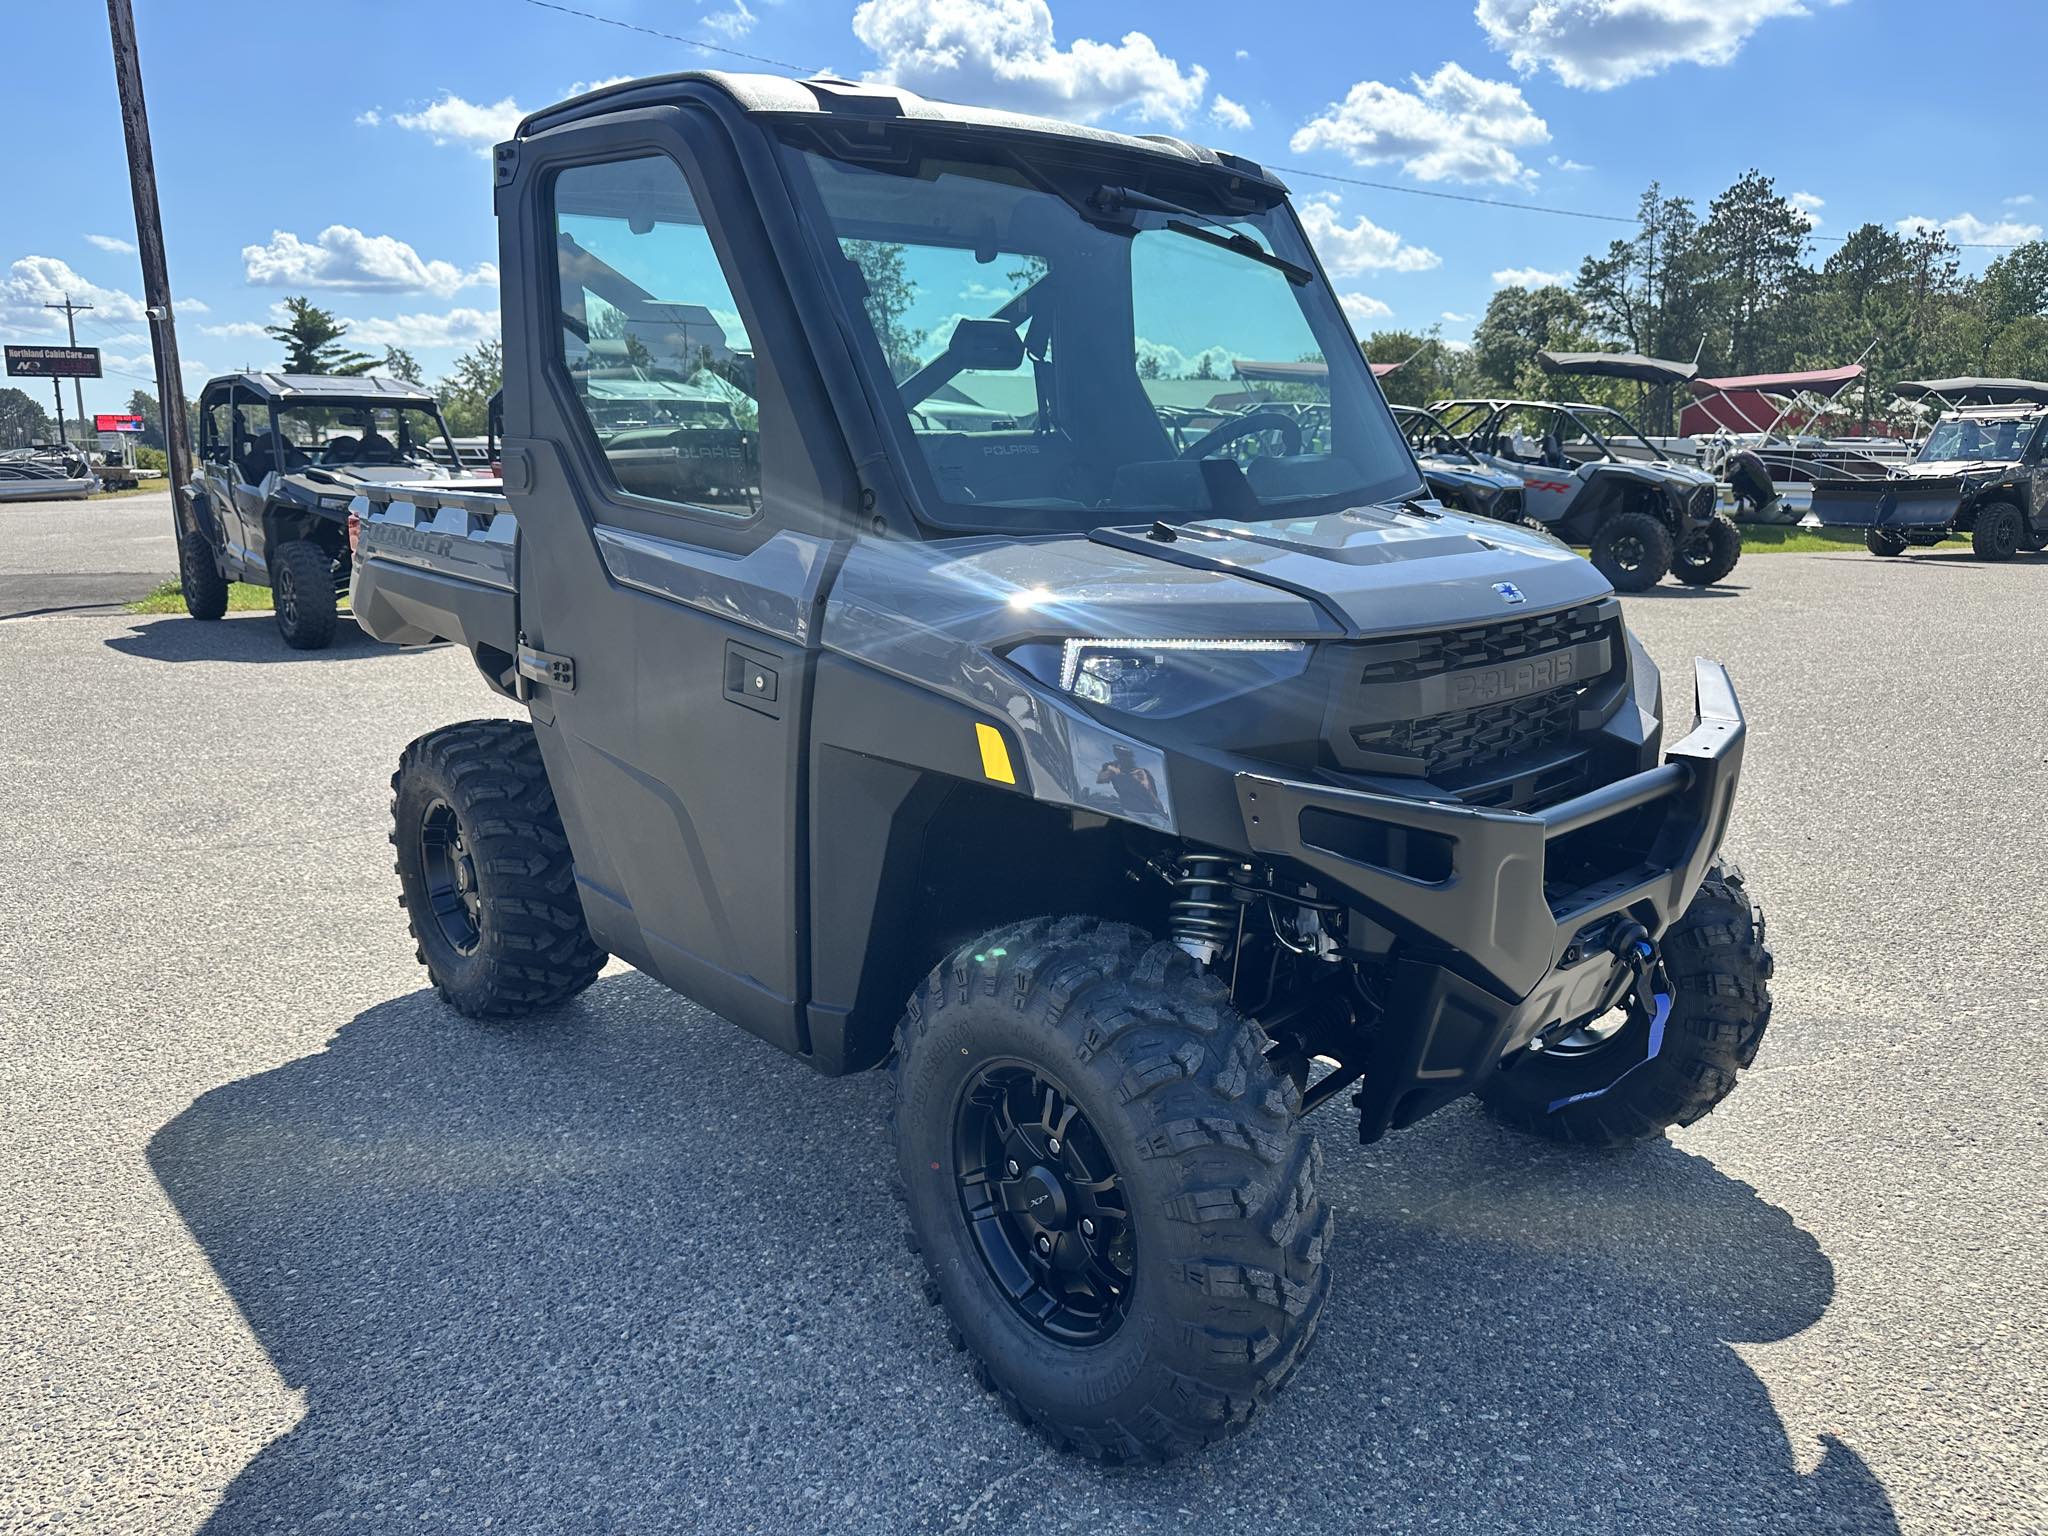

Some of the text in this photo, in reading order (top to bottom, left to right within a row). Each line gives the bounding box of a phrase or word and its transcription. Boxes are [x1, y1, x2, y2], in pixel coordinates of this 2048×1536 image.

[983, 445, 1040, 456] POLARIS
[373, 524, 454, 558] RANGER
[1456, 652, 1573, 703] POLARIS
[1030, 1194, 1049, 1208] XP
